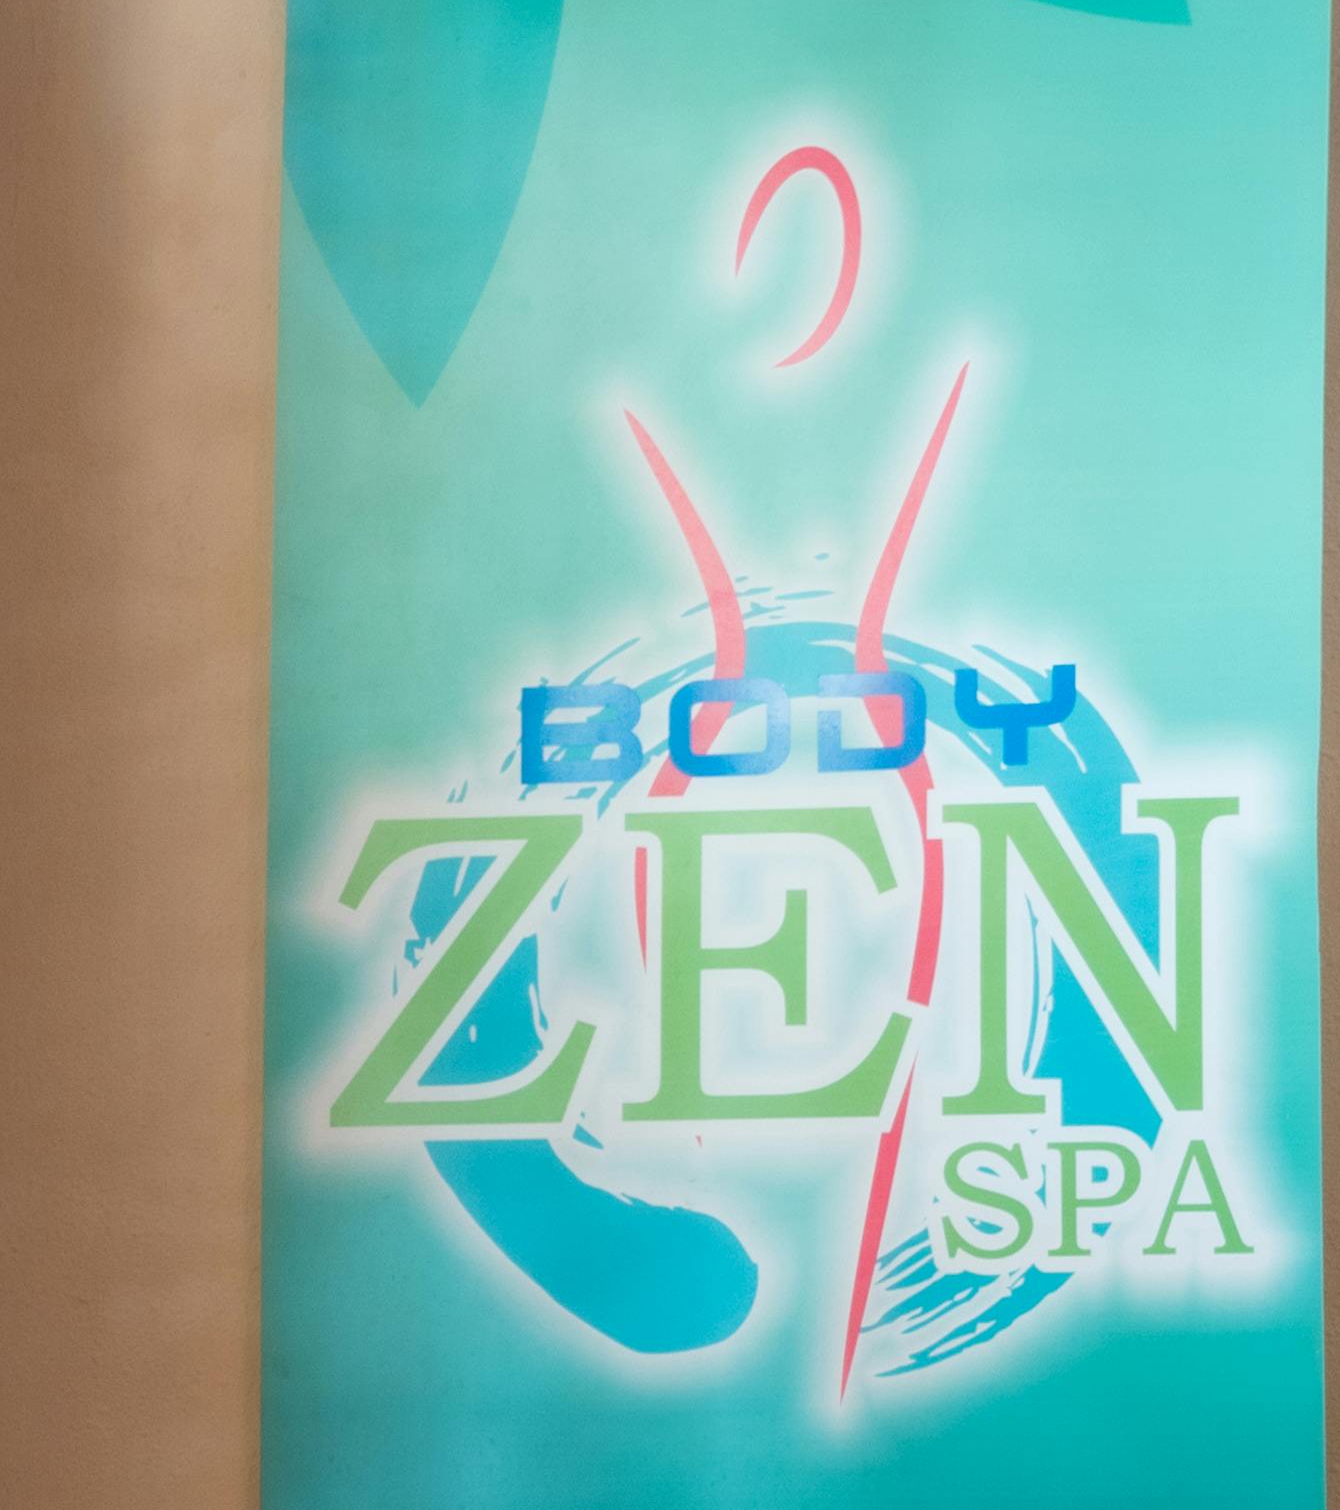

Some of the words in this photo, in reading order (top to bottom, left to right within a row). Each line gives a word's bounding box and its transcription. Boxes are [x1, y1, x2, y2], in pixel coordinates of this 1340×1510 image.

[519, 664, 1077, 785] BODY
[329, 795, 1240, 1130] ZEN
[941, 1139, 1255, 1261] SPA
